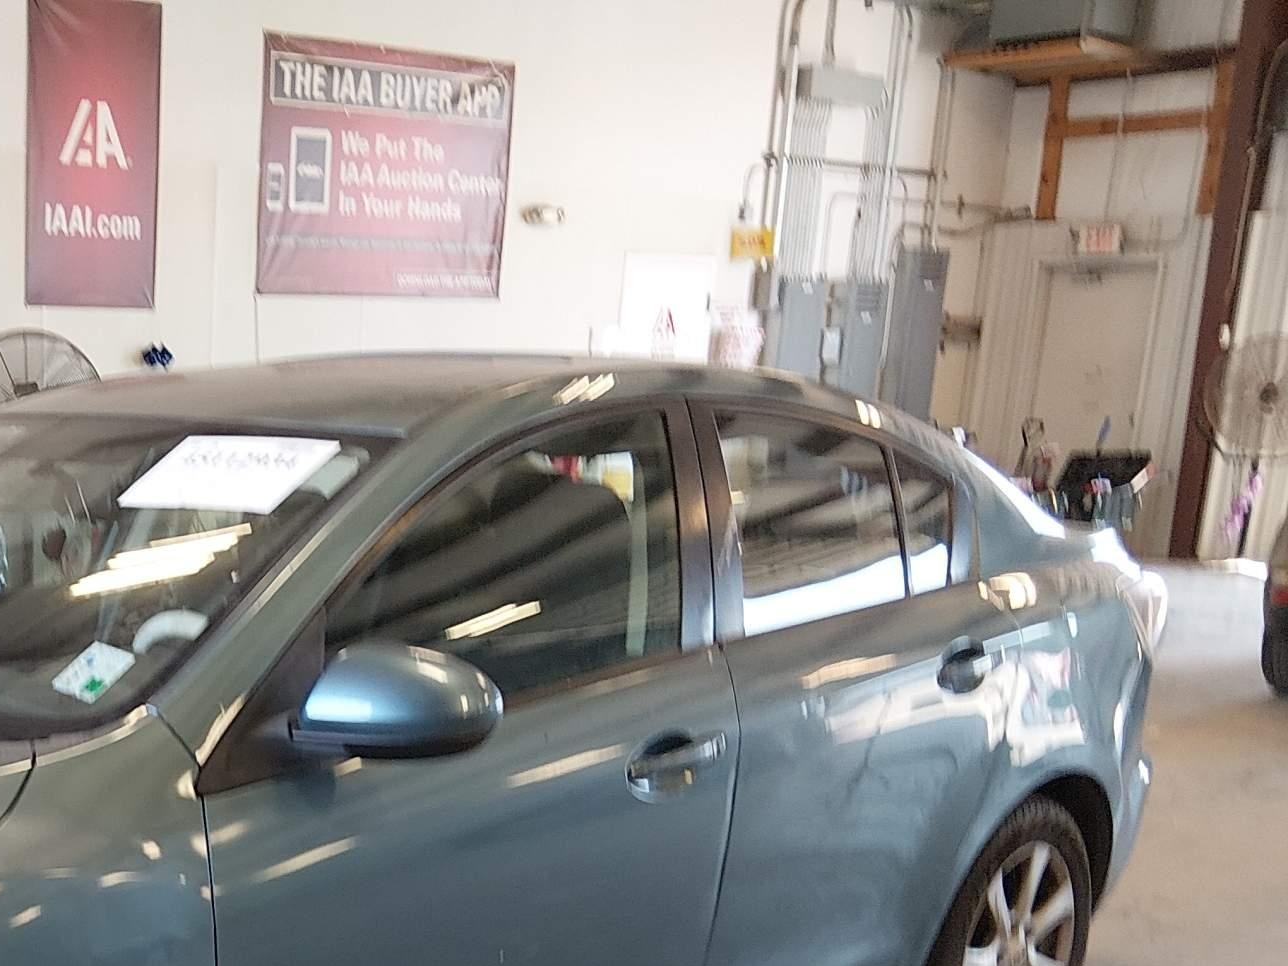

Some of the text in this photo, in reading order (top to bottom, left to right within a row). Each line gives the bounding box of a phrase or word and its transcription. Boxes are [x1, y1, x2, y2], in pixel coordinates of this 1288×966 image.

[279, 60, 327, 100] THE
[332, 65, 375, 106] IAA
[379, 70, 453, 114] BUYER
[341, 129, 445, 163] We Put The
[340, 159, 376, 187] IAA
[376, 162, 444, 192] Auction
[44, 201, 141, 241] IAAI.com
[339, 189, 463, 221] In Your Hands
